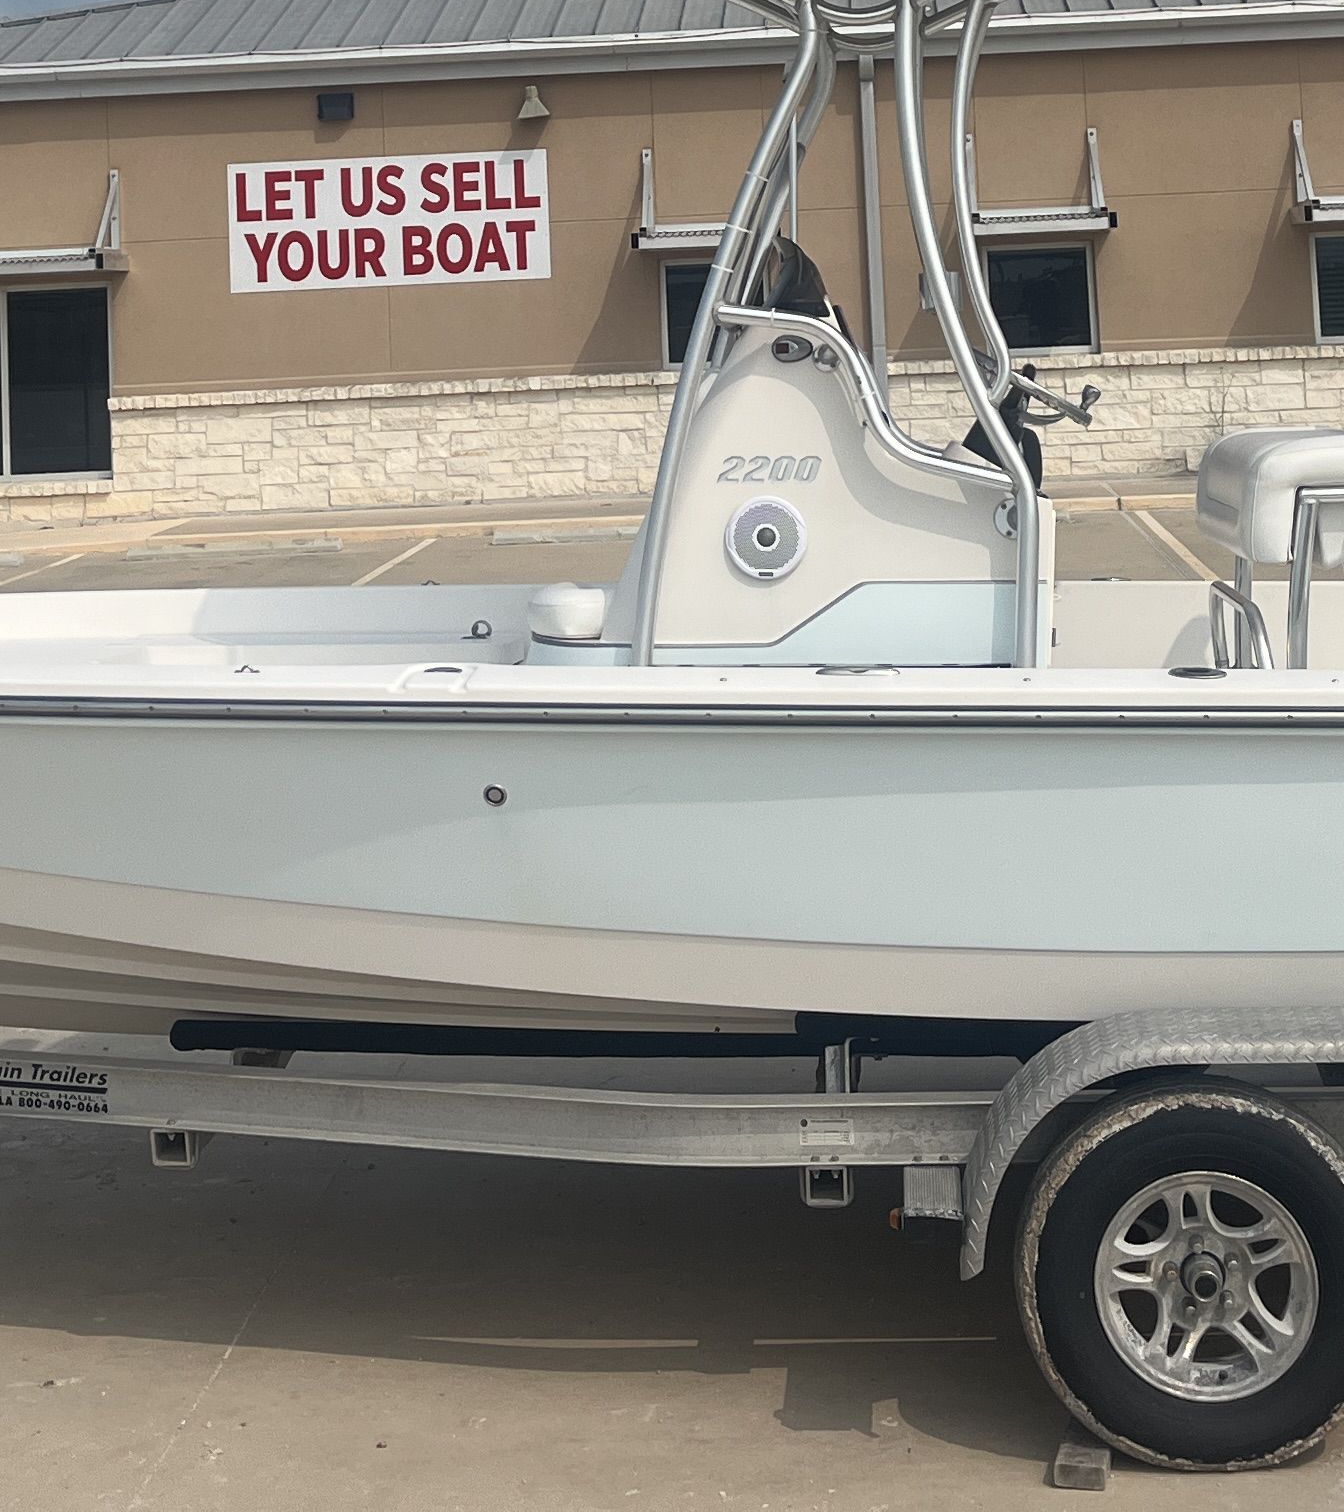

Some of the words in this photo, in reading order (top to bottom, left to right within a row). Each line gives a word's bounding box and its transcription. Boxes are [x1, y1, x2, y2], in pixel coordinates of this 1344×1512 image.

[235, 168, 325, 222] LET
[340, 164, 406, 217] US
[420, 158, 541, 213] SELL
[244, 227, 387, 283] YOUR
[402, 219, 536, 276] BOAT
[717, 455, 823, 484] 2200
[31, 1063, 109, 1086] Trailers
[11, 1090, 50, 1099] LONG
[18, 1097, 109, 1114] 800-490-0664
